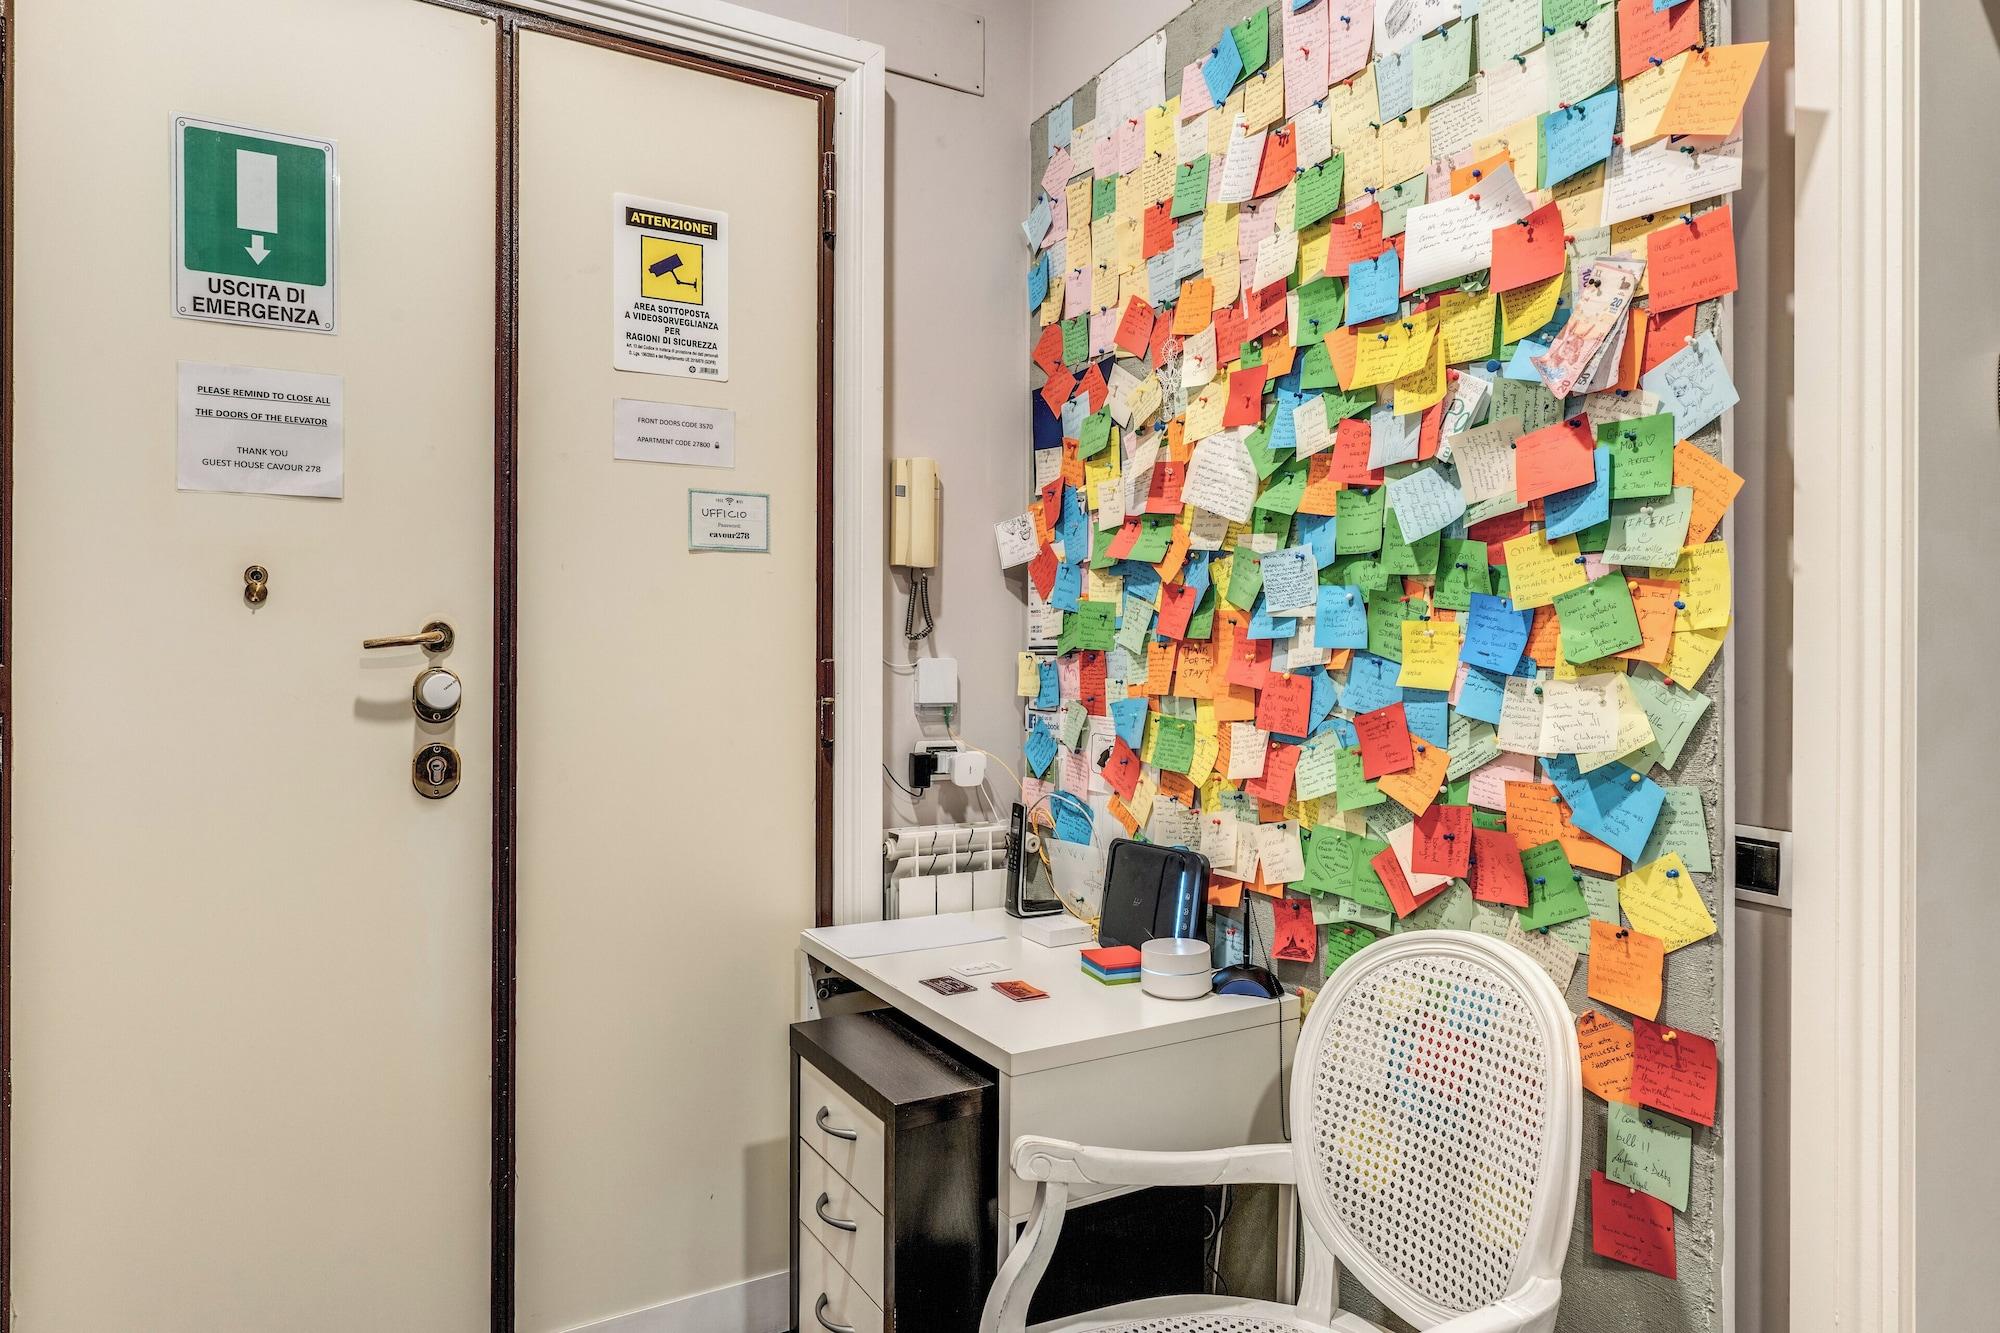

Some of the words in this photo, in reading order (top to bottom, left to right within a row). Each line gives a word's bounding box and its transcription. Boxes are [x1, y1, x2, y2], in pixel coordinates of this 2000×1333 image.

[631, 212, 712, 235] ATTENZIONE!
[209, 277, 280, 301] USCITA
[287, 287, 304, 304] DI
[192, 296, 319, 325] EMERGENZA
[634, 302, 655, 311] AREA
[658, 305, 710, 319] SOTTOPOSTA
[1610, 298, 1623, 308] 20
[625, 311, 630, 319] A
[633, 312, 718, 330] VIDEOSORVEGLIANZA
[665, 327, 680, 335] PER
[626, 332, 660, 343] RAGIONI
[673, 338, 717, 350] SICUREZZA
[197, 385, 230, 395] PLEASE
[233, 389, 270, 399] REMIND
[272, 392, 284, 400] TO
[286, 394, 313, 403] CLOSE
[195, 408, 212, 416] THE
[216, 410, 248, 419] DOORS
[265, 414, 282, 422] THE
[284, 416, 327, 426] ELEVATOR
[637, 437, 673, 445] APARTMENT
[237, 447, 267, 455] THANK
[270, 449, 288, 457] YOU
[202, 459, 231, 467] GUEST
[234, 461, 264, 469] HOUSE
[267, 463, 303, 472] CAVOUR
[702, 509, 747, 518] UFFICIO
